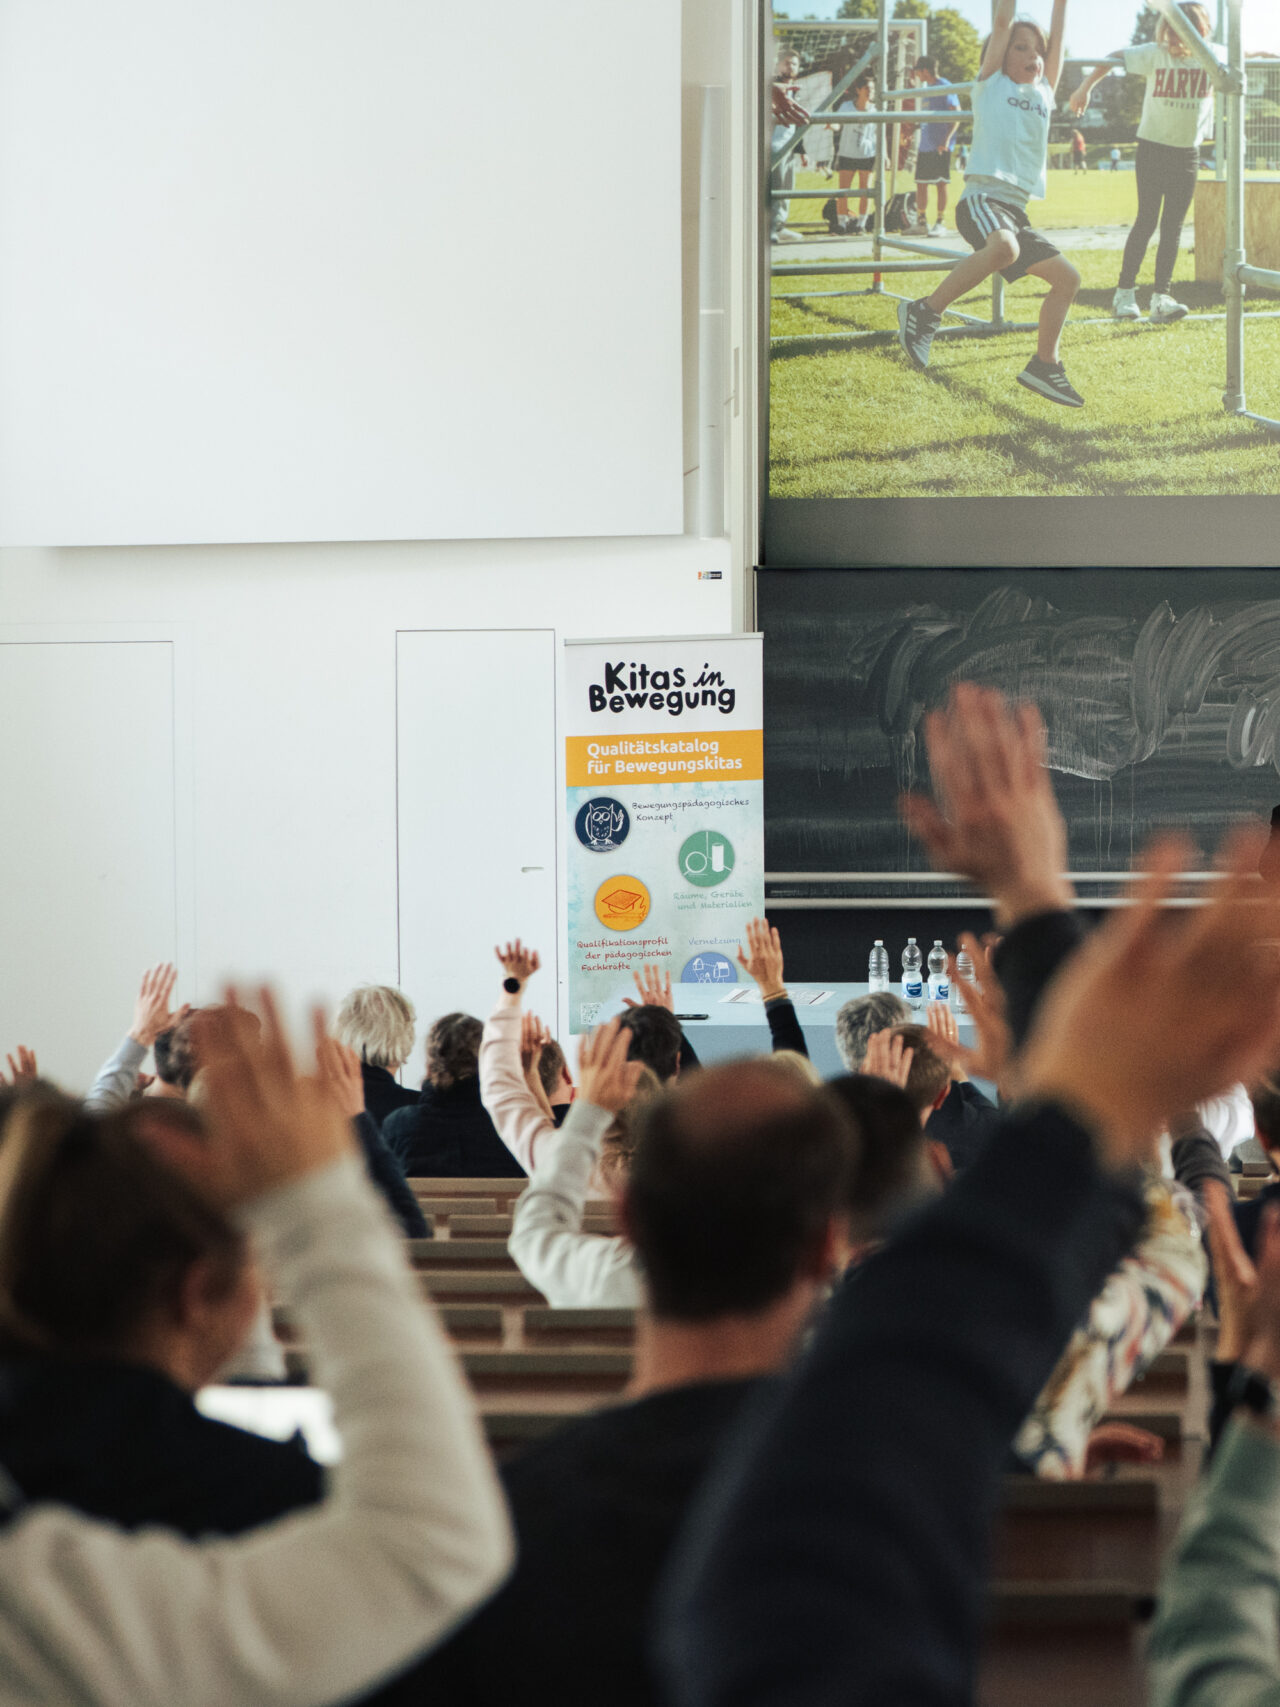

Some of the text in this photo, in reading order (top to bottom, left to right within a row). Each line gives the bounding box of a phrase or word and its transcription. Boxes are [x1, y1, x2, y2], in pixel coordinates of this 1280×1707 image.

[1152, 67, 1212, 98] HARVA
[605, 661, 725, 694] Kitas in
[589, 684, 735, 716] Bewegung
[587, 738, 719, 759] Qualitätskatalog
[587, 756, 743, 775] für Bewegungskitas
[631, 798, 750, 812] Bewegungspädagogisches
[636, 813, 674, 824] Konzept
[576, 936, 669, 949] Qualifikationsprofil
[585, 952, 601, 960] der
